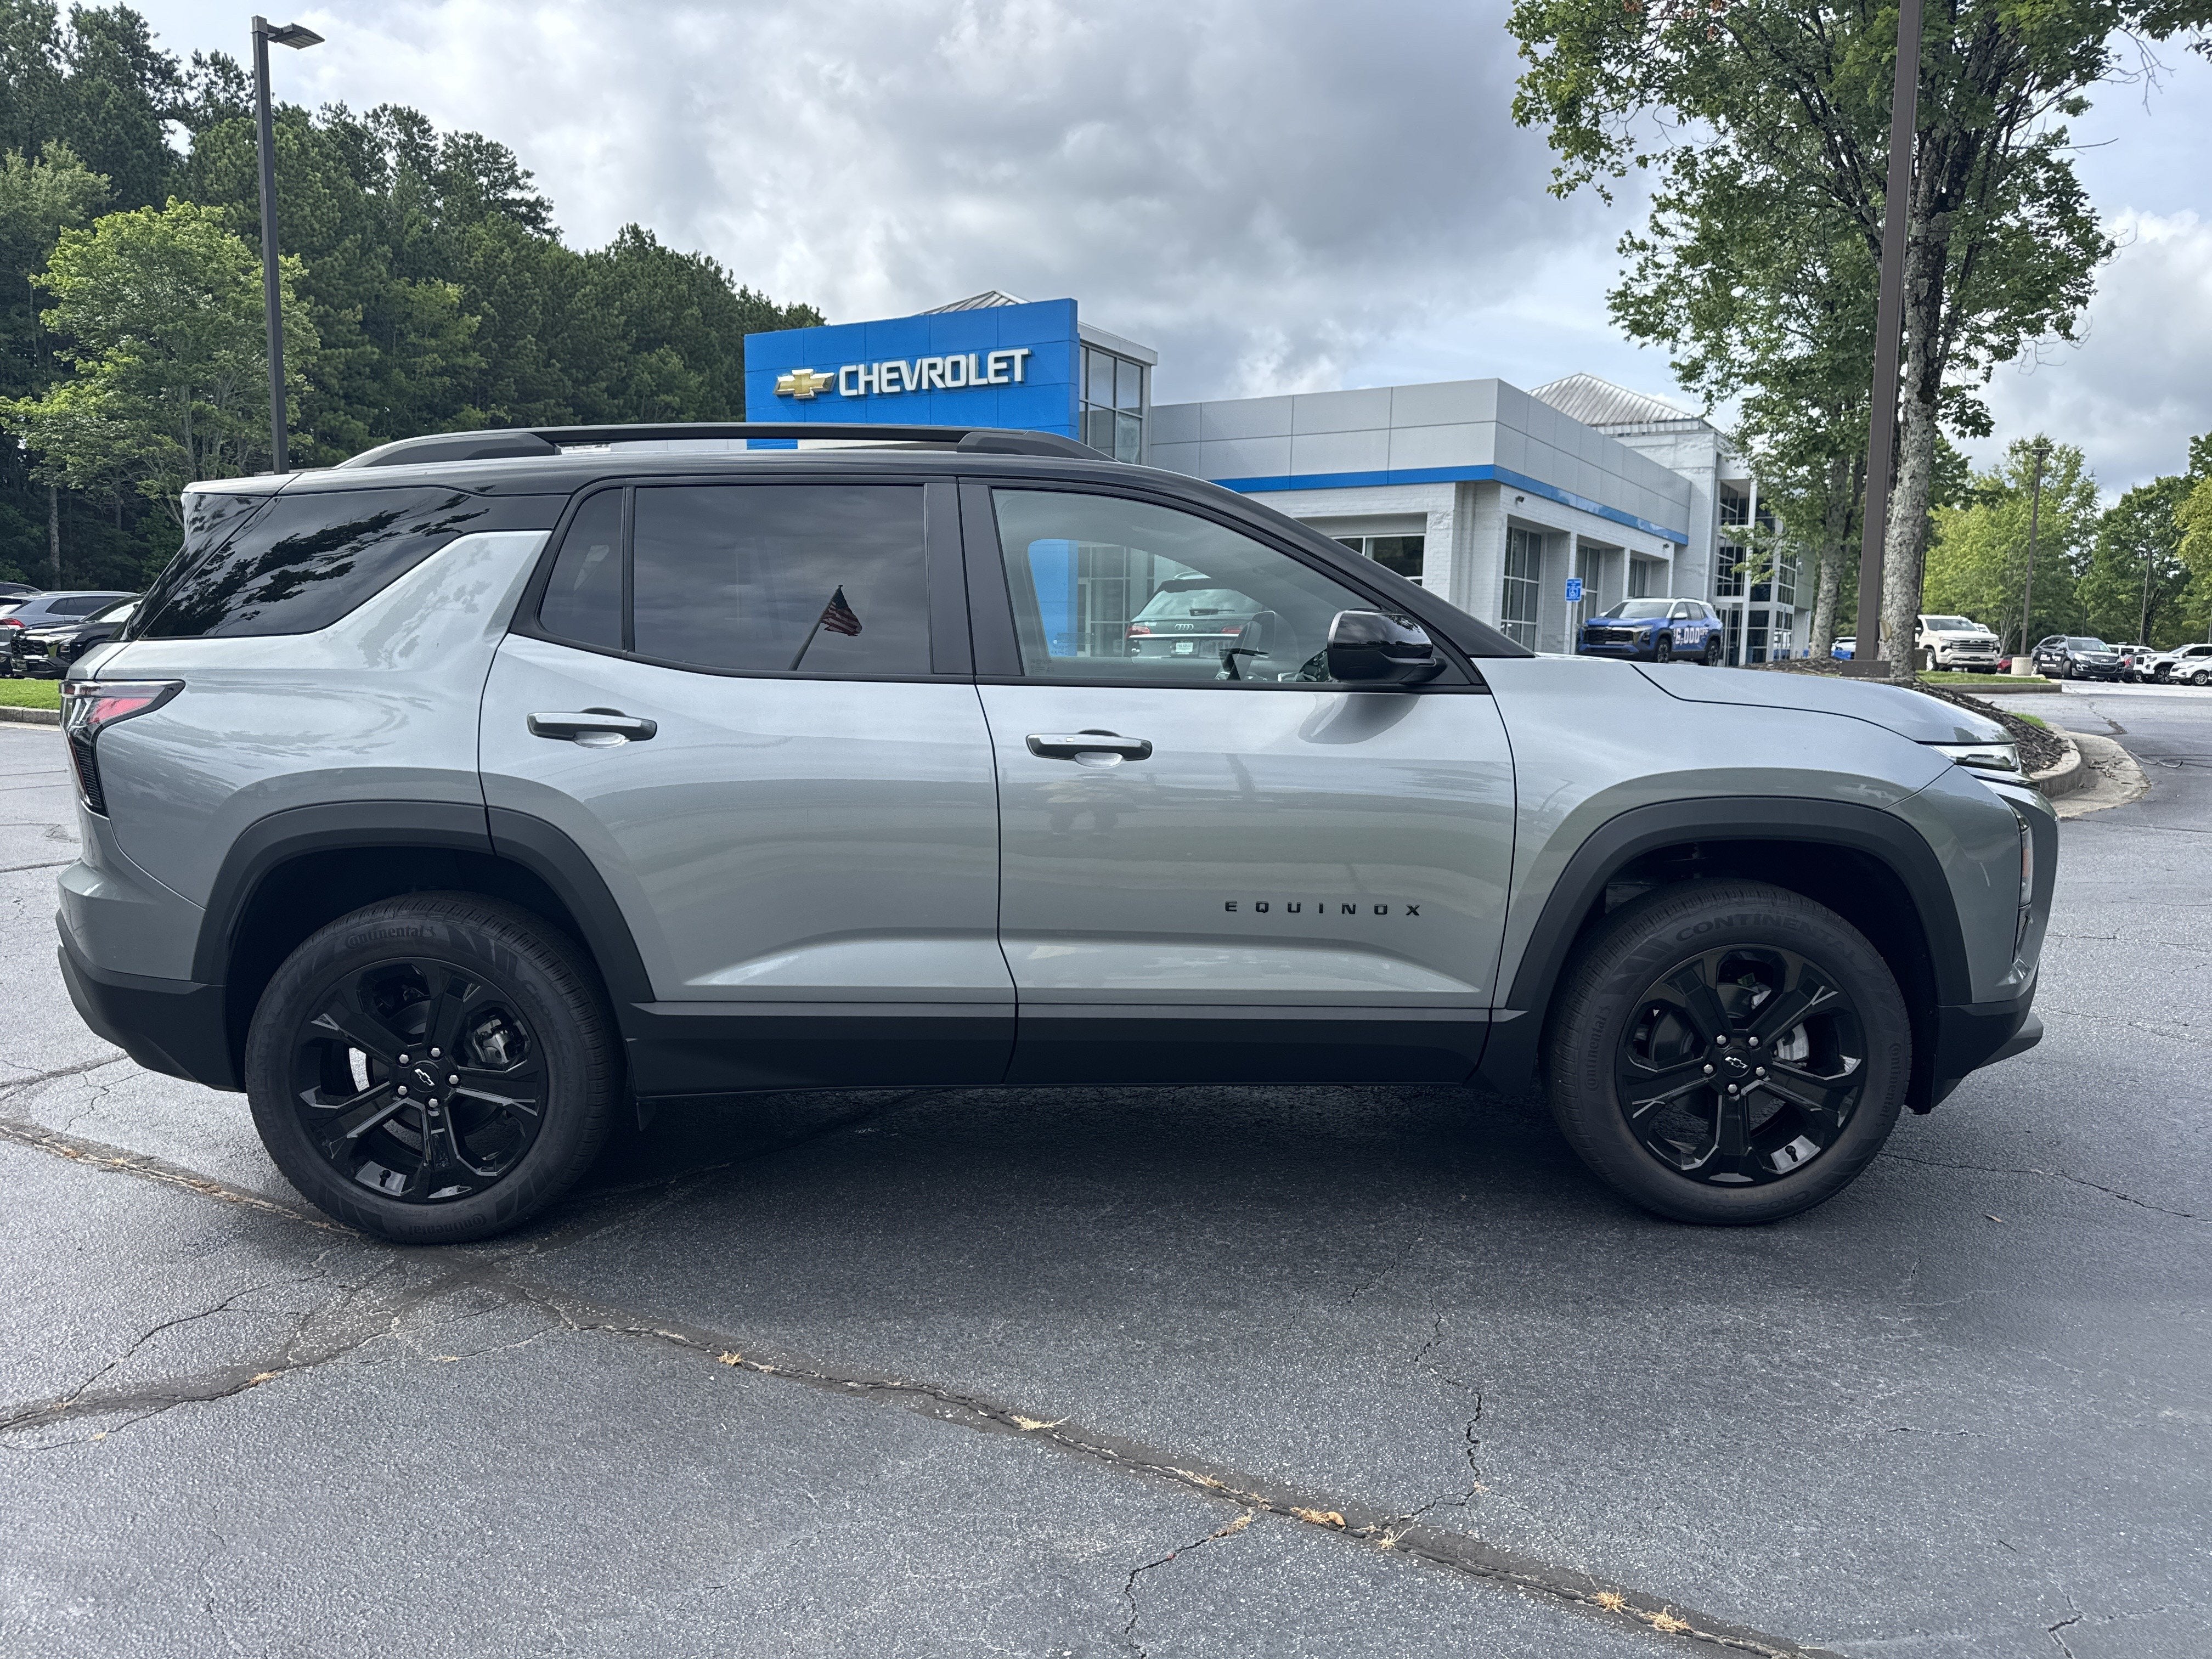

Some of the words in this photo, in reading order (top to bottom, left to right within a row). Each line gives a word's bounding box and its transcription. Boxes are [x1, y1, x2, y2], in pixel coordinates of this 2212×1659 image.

[839, 348, 1030, 396] CHEVROLET
[1673, 628, 1700, 646] $6,000
[1225, 900, 1420, 916] EQUINOX
[345, 925, 425, 949] Continental
[1675, 913, 1857, 963] CONTINENTAL
[1584, 1014, 1607, 1092] Continental
[1878, 1042, 1901, 1119] Continental
[409, 1214, 487, 1236] Continental
